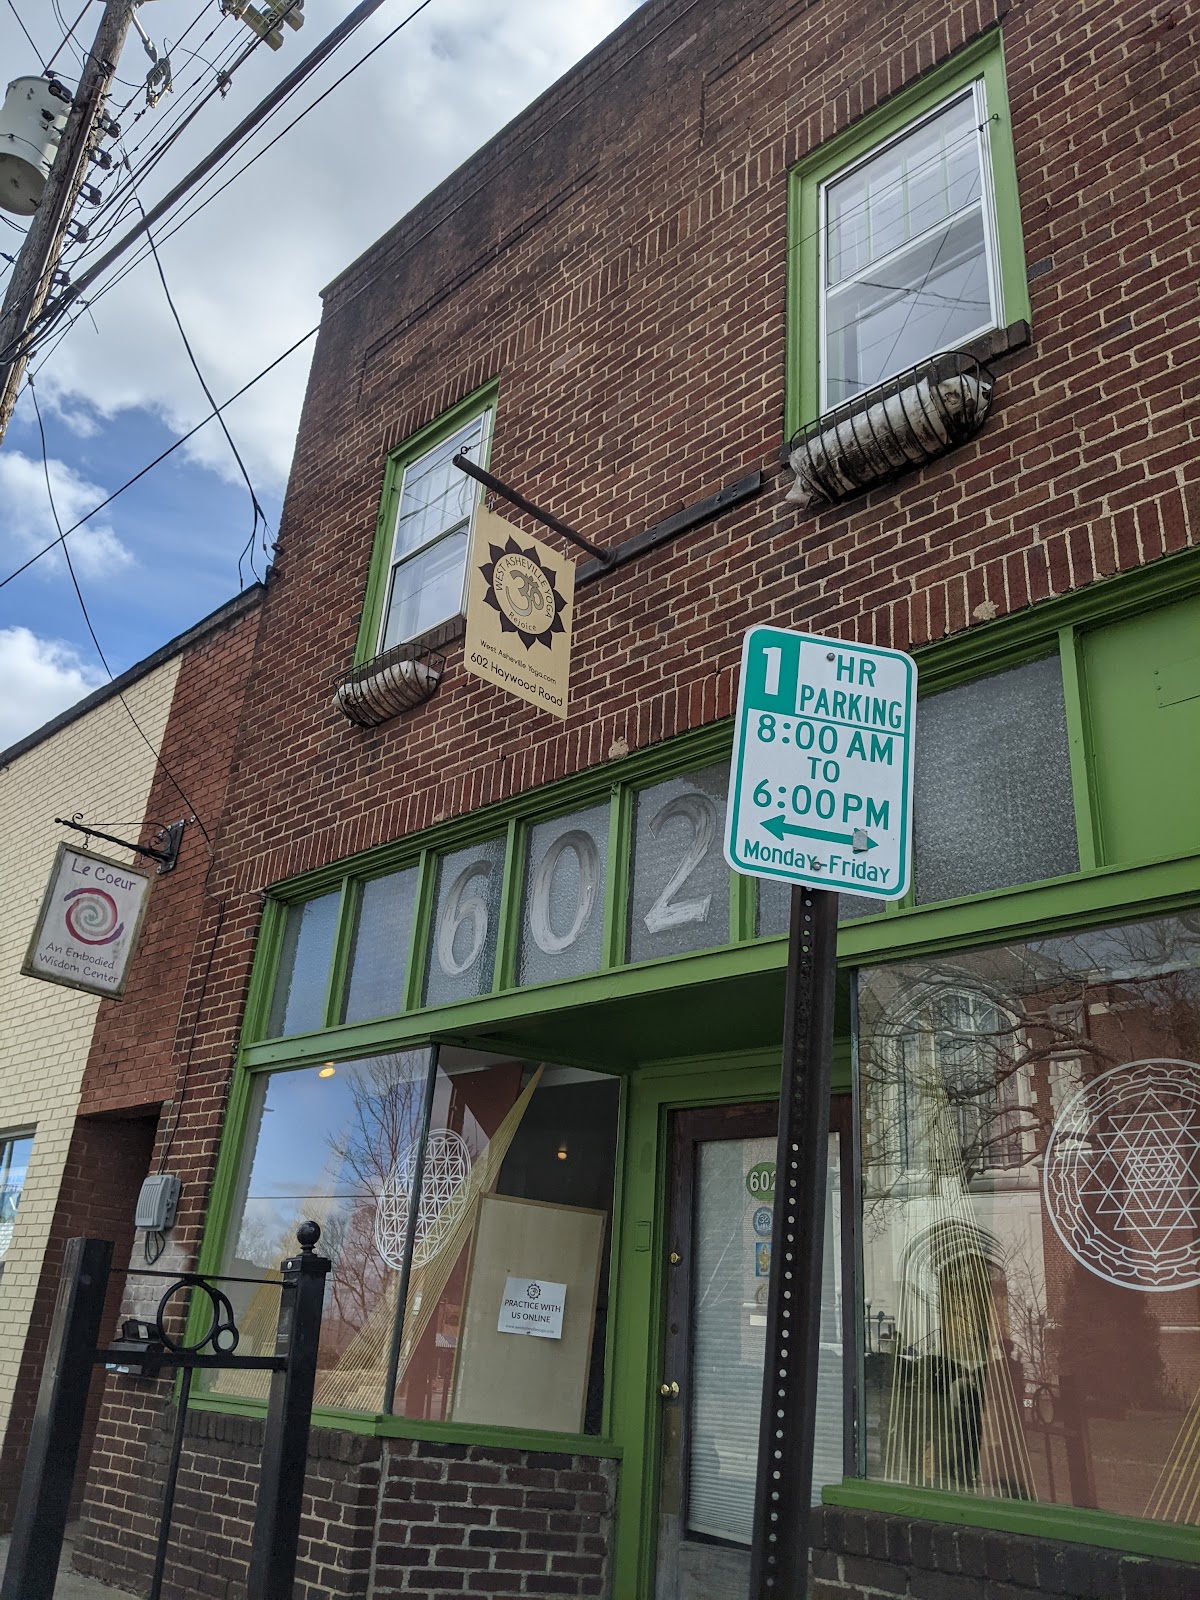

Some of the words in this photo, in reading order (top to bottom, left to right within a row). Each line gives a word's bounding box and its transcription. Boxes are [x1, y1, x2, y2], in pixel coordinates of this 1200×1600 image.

[495, 563, 506, 591] WEST
[505, 556, 547, 587] ASHEVILLE
[544, 589, 554, 619] YOGA
[508, 611, 537, 632] Rejoice
[480, 639, 497, 654] West
[498, 649, 527, 669] Asheville
[528, 664, 556, 685] Yoga.com
[762, 646, 782, 696] 1
[836, 654, 877, 688] HR
[470, 652, 489, 669] 602
[490, 661, 537, 693] Haywood
[538, 686, 563, 707] Road
[799, 684, 902, 729] PARKING
[757, 714, 838, 754] 8:00
[846, 730, 894, 765] AM
[807, 756, 840, 783] TO
[752, 778, 836, 820] 6:00
[842, 792, 890, 831] PM
[71, 857, 91, 876] Le
[94, 866, 137, 891] Coeur
[39, 952, 80, 974] Wisdom
[83, 966, 119, 984] Center
[45, 941, 63, 954] An
[65, 947, 115, 970] Embodied
[504, 1299, 539, 1310] PRACTICE
[540, 1303, 561, 1313] WITH
[511, 1311, 522, 1320] US
[522, 1313, 551, 1323] ONLINE
